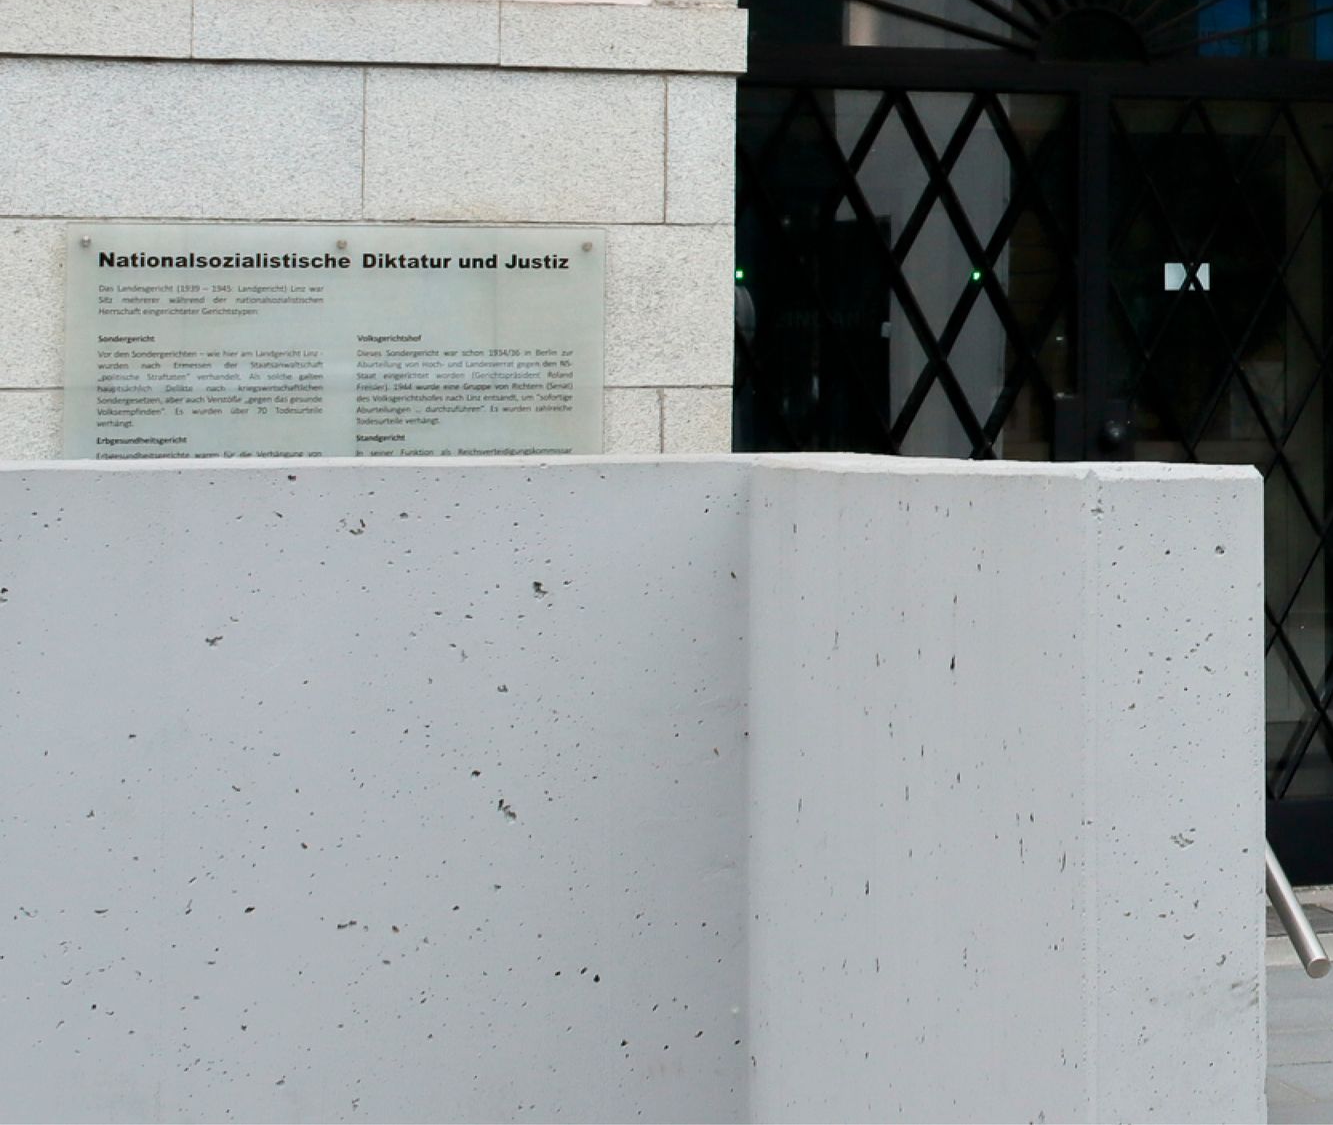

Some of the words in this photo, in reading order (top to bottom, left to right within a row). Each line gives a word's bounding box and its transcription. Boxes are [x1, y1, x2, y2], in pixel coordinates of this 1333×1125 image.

[98, 251, 351, 269] Nationalsozialistische
[362, 251, 452, 269] Diktatur
[458, 251, 498, 269] und
[505, 251, 569, 269] Justiz
[97, 335, 155, 344] Sondergericht
[357, 335, 422, 344] Volksgerichtshof
[95, 437, 188, 445] Erbgesundheitsgericht
[356, 434, 406, 443] Standgericht
